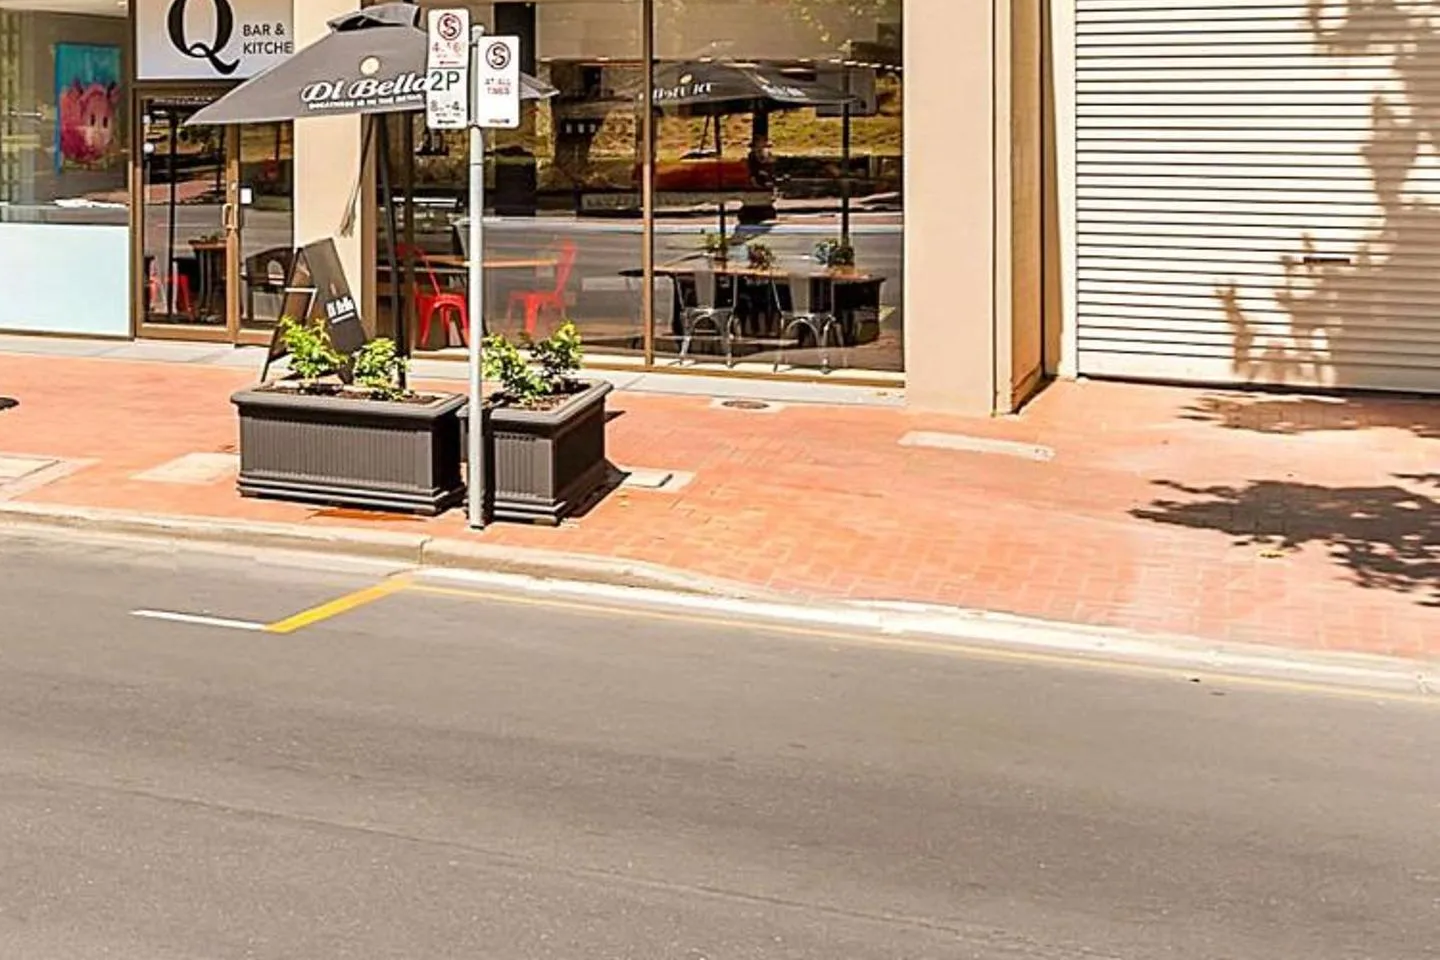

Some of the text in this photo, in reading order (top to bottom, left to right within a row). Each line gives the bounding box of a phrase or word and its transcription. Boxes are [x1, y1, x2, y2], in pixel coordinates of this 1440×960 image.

[243, 23, 285, 37] BAR &
[243, 42, 294, 55] KITCHE
[430, 71, 460, 91] 2P
